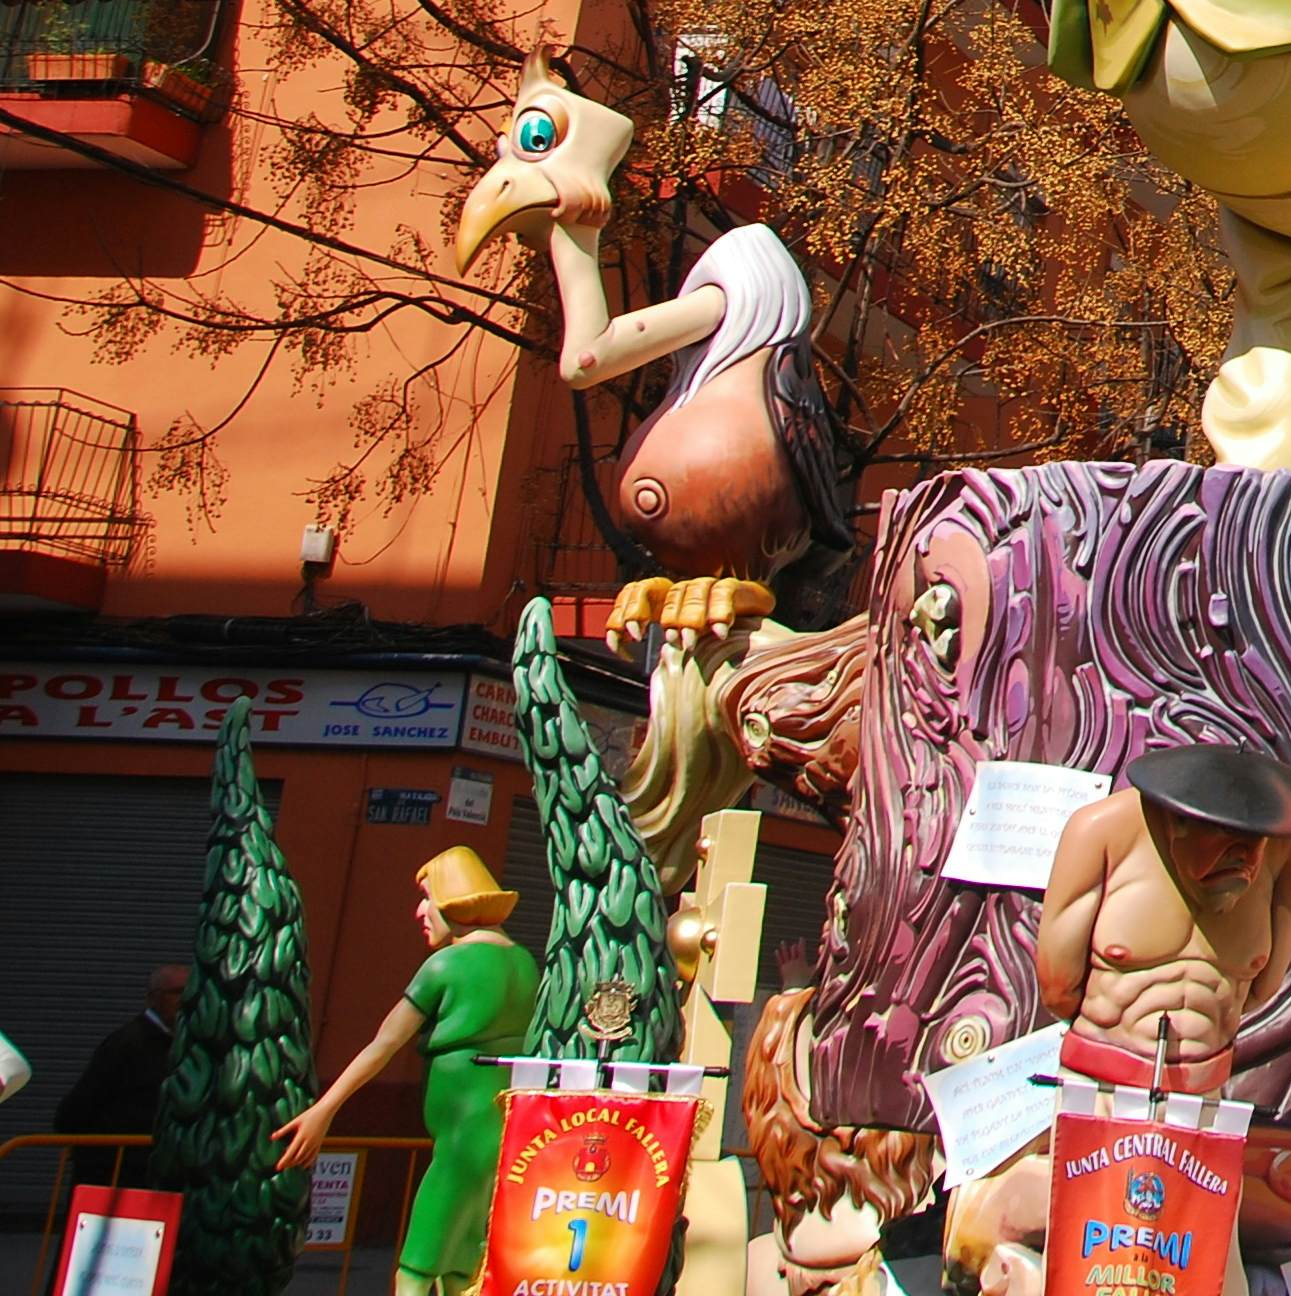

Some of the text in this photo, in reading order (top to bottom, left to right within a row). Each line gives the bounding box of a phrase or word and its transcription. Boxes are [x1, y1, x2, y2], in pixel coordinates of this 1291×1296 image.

[0, 674, 305, 704] POLLOS
[0, 705, 40, 727] A
[323, 724, 449, 738] JOSE SANCHEZ
[506, 1108, 671, 1189] JUNTA LOCAL FALLERA
[1065, 1132, 1228, 1195] JUNTA CENTRAL FALLERA
[531, 1186, 641, 1225] PREMI
[567, 1217, 588, 1273] 1
[1081, 1218, 1193, 1271] PREMI
[1085, 1263, 1176, 1293] MILLOR
